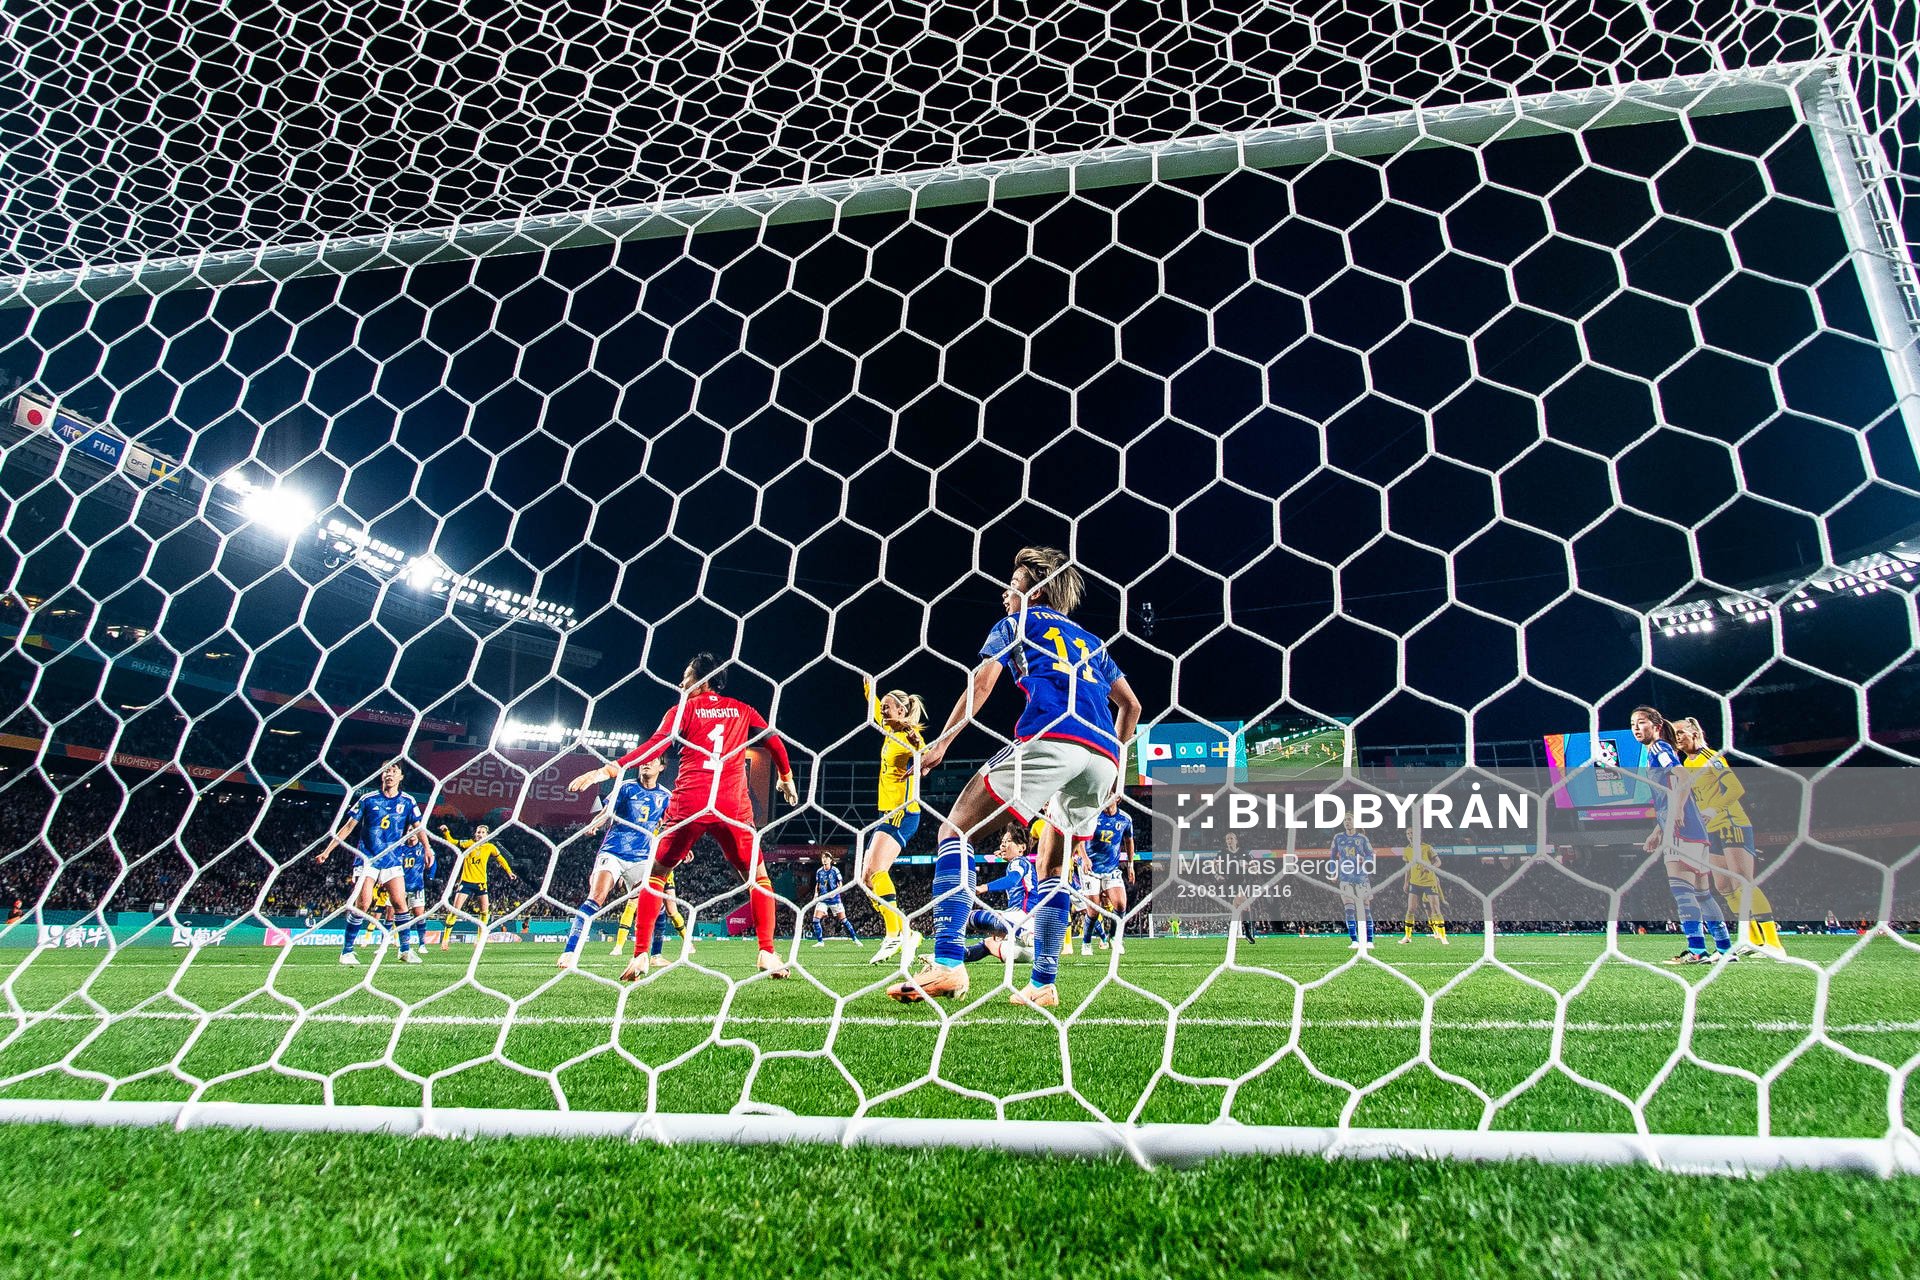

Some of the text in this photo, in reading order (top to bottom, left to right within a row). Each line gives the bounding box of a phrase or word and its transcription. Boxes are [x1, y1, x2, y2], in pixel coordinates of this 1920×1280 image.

[92, 439, 116, 457] FIFA
[130, 458, 148, 470] OFC
[1031, 611, 1068, 623] TAN
[1043, 627, 1098, 683] 11
[695, 707, 740, 719] YAMASHITA
[702, 723, 725, 771] 1
[1179, 745, 1204, 755] 0 0
[119, 754, 160, 769] WOMEN'S
[192, 767, 213, 777] CUP
[466, 760, 560, 782] BEYOND
[638, 806, 650, 822] 3
[380, 815, 391, 830] 6
[1100, 829, 1114, 844] 12
[1873, 827, 1894, 836] CUP
[1345, 847, 1356, 857] 14
[404, 857, 415, 868] 10
[297, 933, 345, 945] AOTEARO
